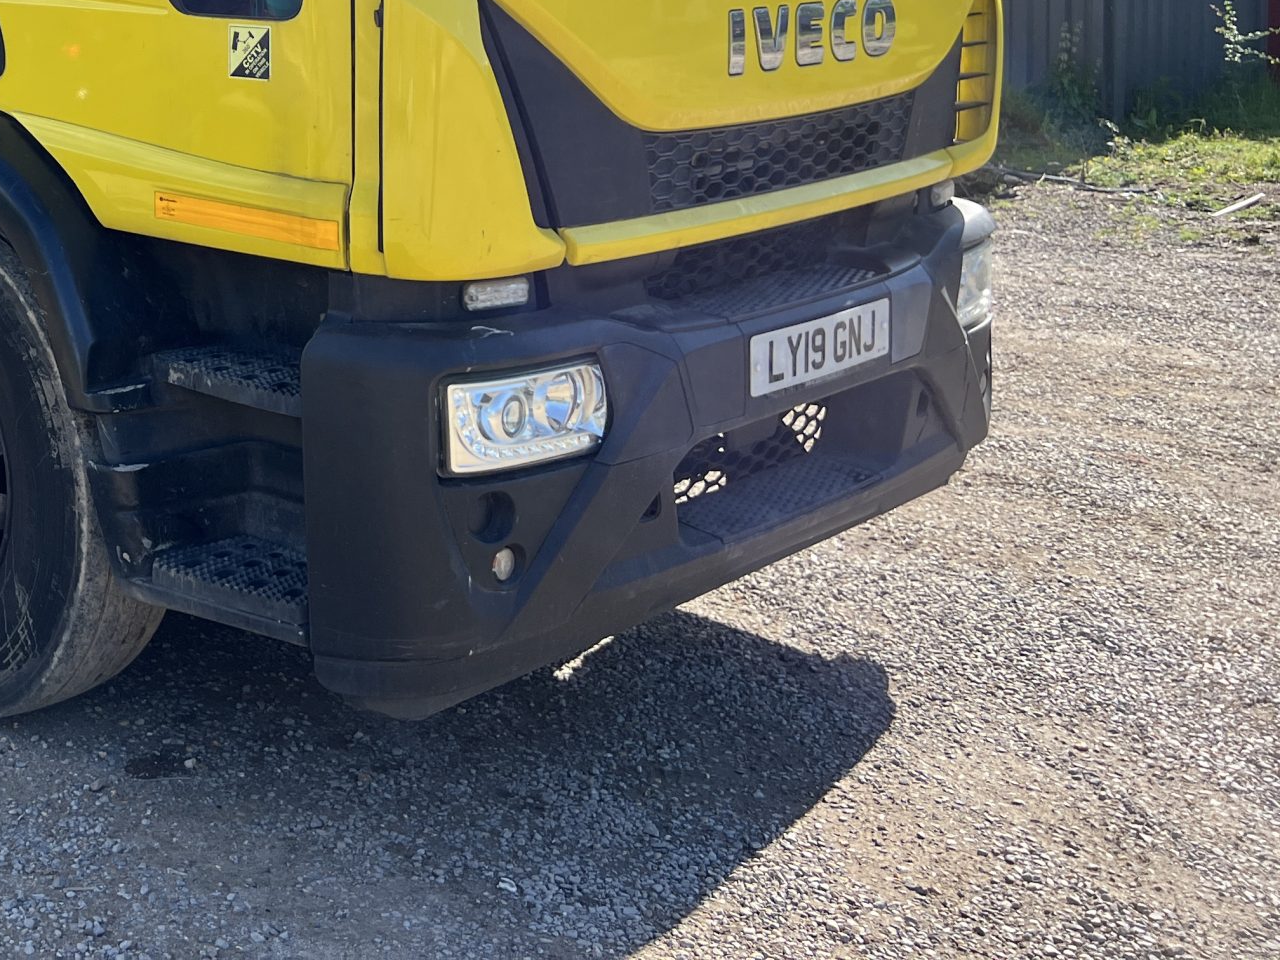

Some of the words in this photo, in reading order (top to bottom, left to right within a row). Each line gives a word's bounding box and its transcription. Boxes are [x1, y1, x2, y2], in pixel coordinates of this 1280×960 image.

[242, 43, 262, 68] CCTV
[768, 327, 826, 384] LY19
[833, 310, 876, 363] GNJ
